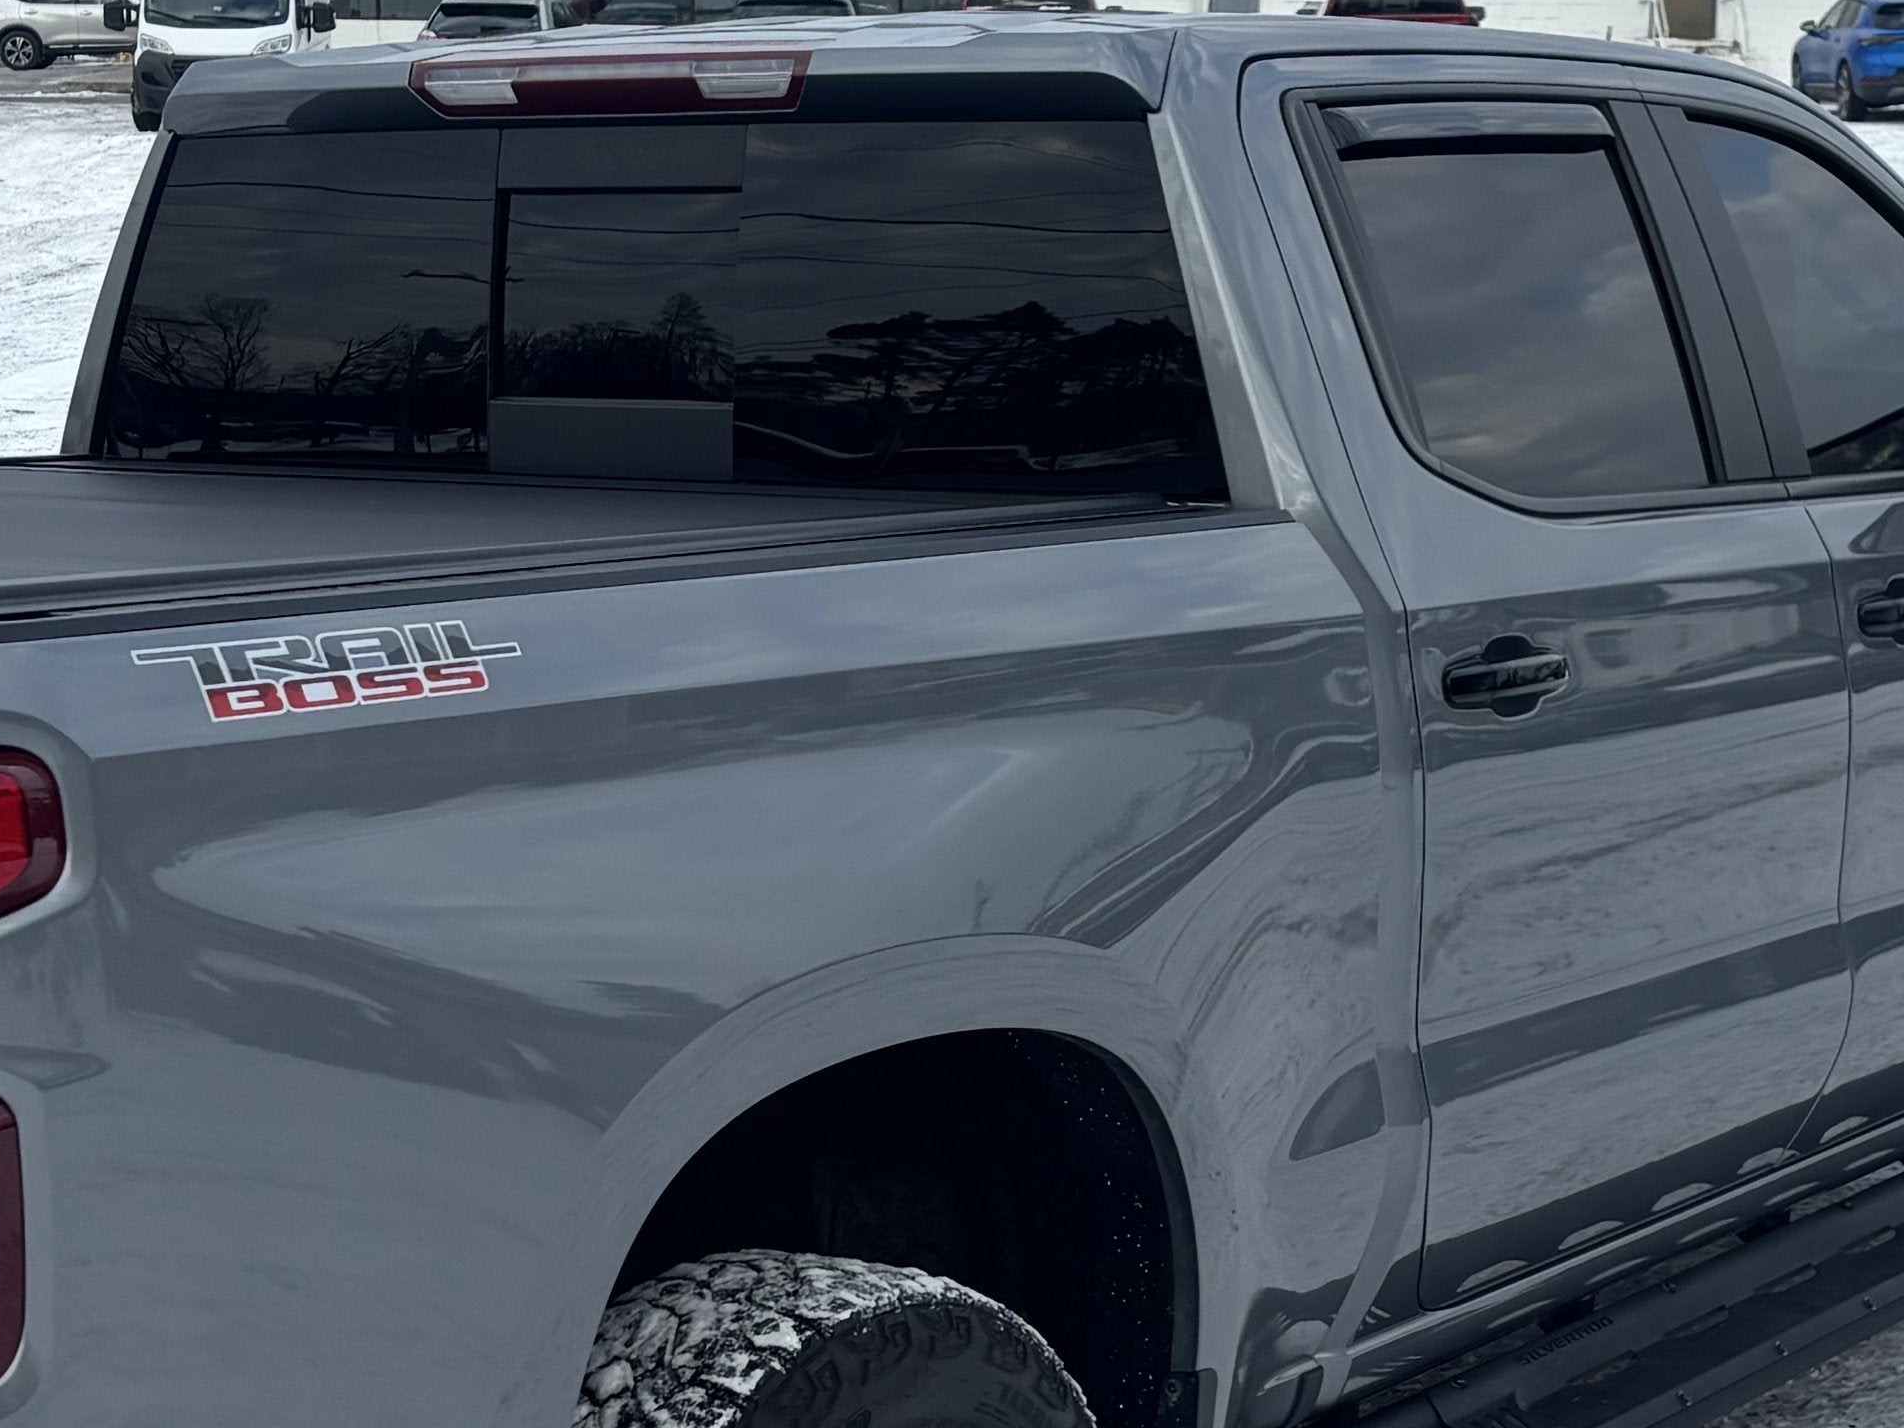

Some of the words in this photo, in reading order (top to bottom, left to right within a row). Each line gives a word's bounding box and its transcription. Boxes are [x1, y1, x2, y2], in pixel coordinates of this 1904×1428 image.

[130, 620, 522, 686] TRAIL
[203, 660, 489, 723] BOSS
[1521, 1316, 1614, 1365] SILVERADO
